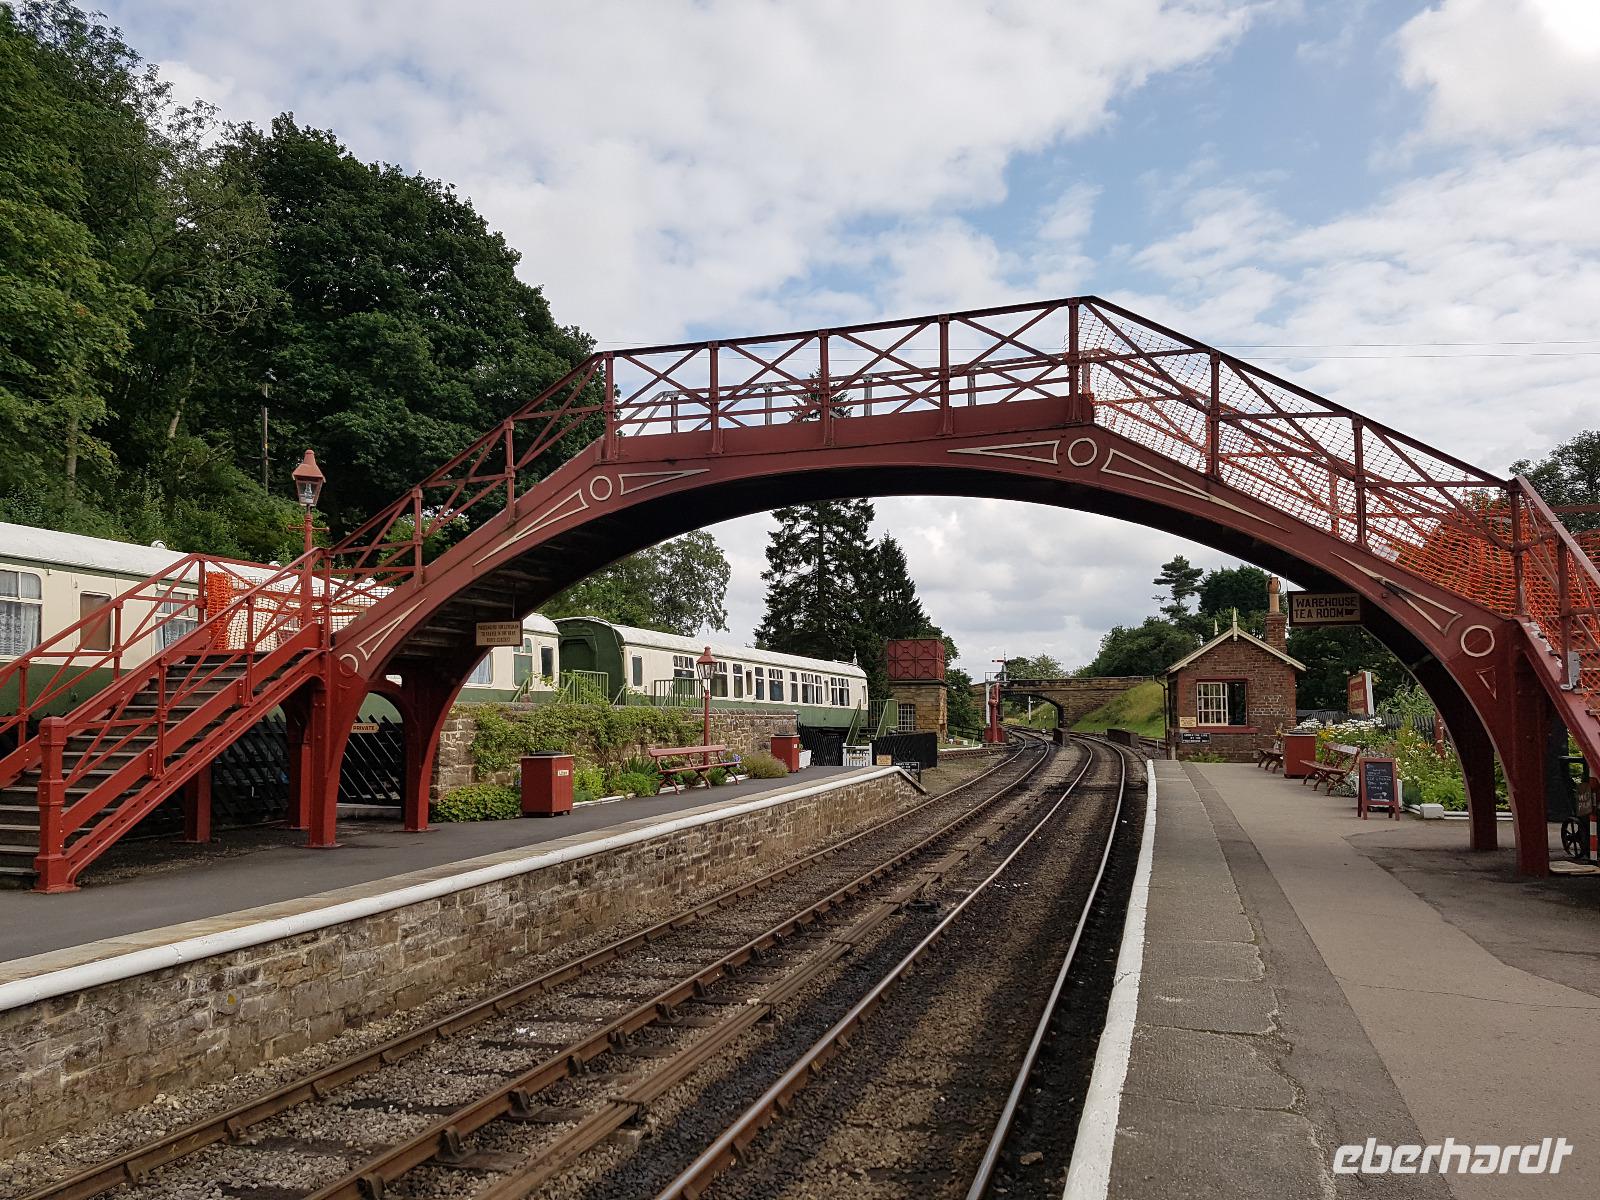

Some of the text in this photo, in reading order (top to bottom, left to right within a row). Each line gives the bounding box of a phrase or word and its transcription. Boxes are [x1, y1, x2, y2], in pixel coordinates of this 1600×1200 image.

[1296, 597, 1358, 608] WAREHOUSE
[1294, 608, 1344, 619] TEA ROOM
